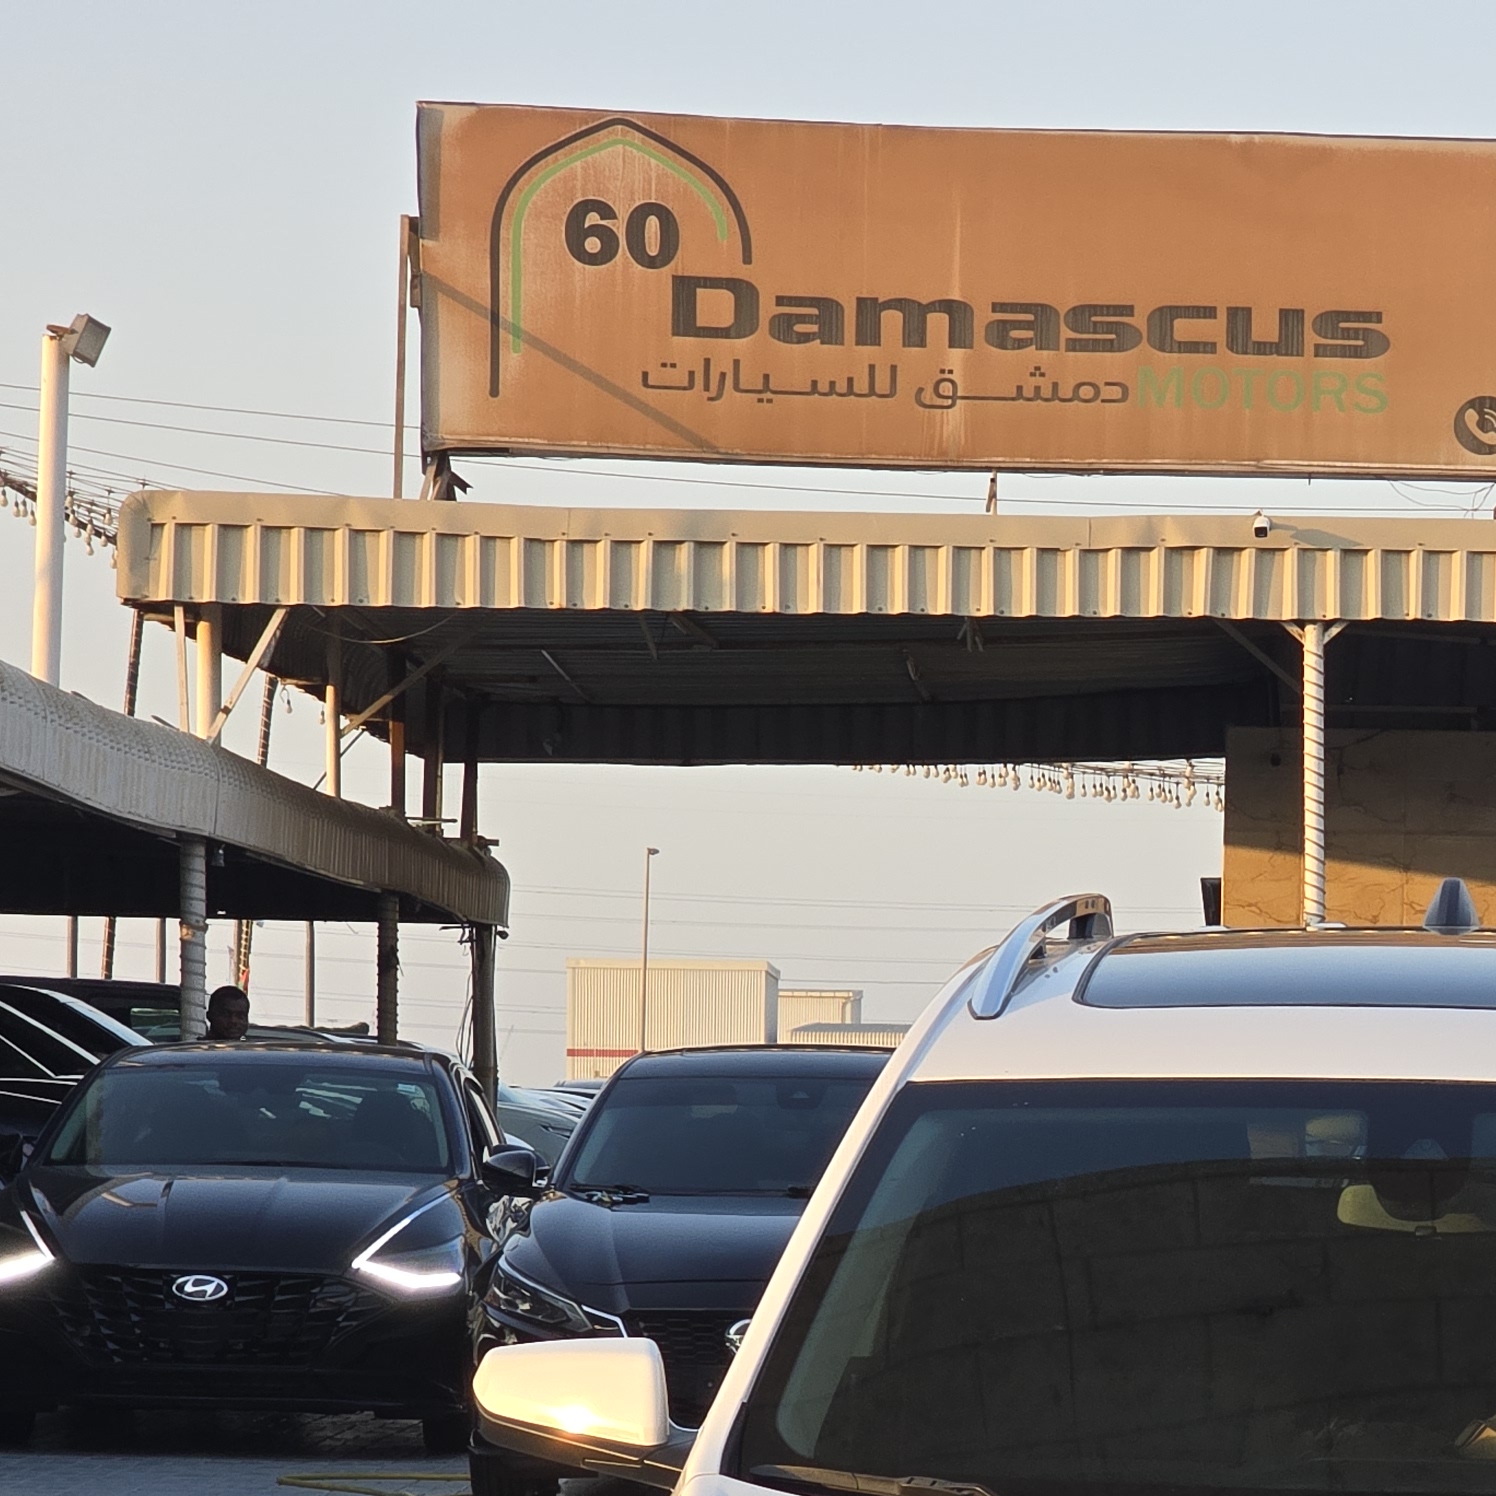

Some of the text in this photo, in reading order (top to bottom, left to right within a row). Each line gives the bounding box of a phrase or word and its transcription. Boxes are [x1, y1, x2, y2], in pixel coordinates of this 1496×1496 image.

[564, 198, 680, 270] 60
[671, 274, 1391, 360] Damascus
[641, 357, 899, 405] للسيارات
[1137, 365, 1389, 414] MOTORS
